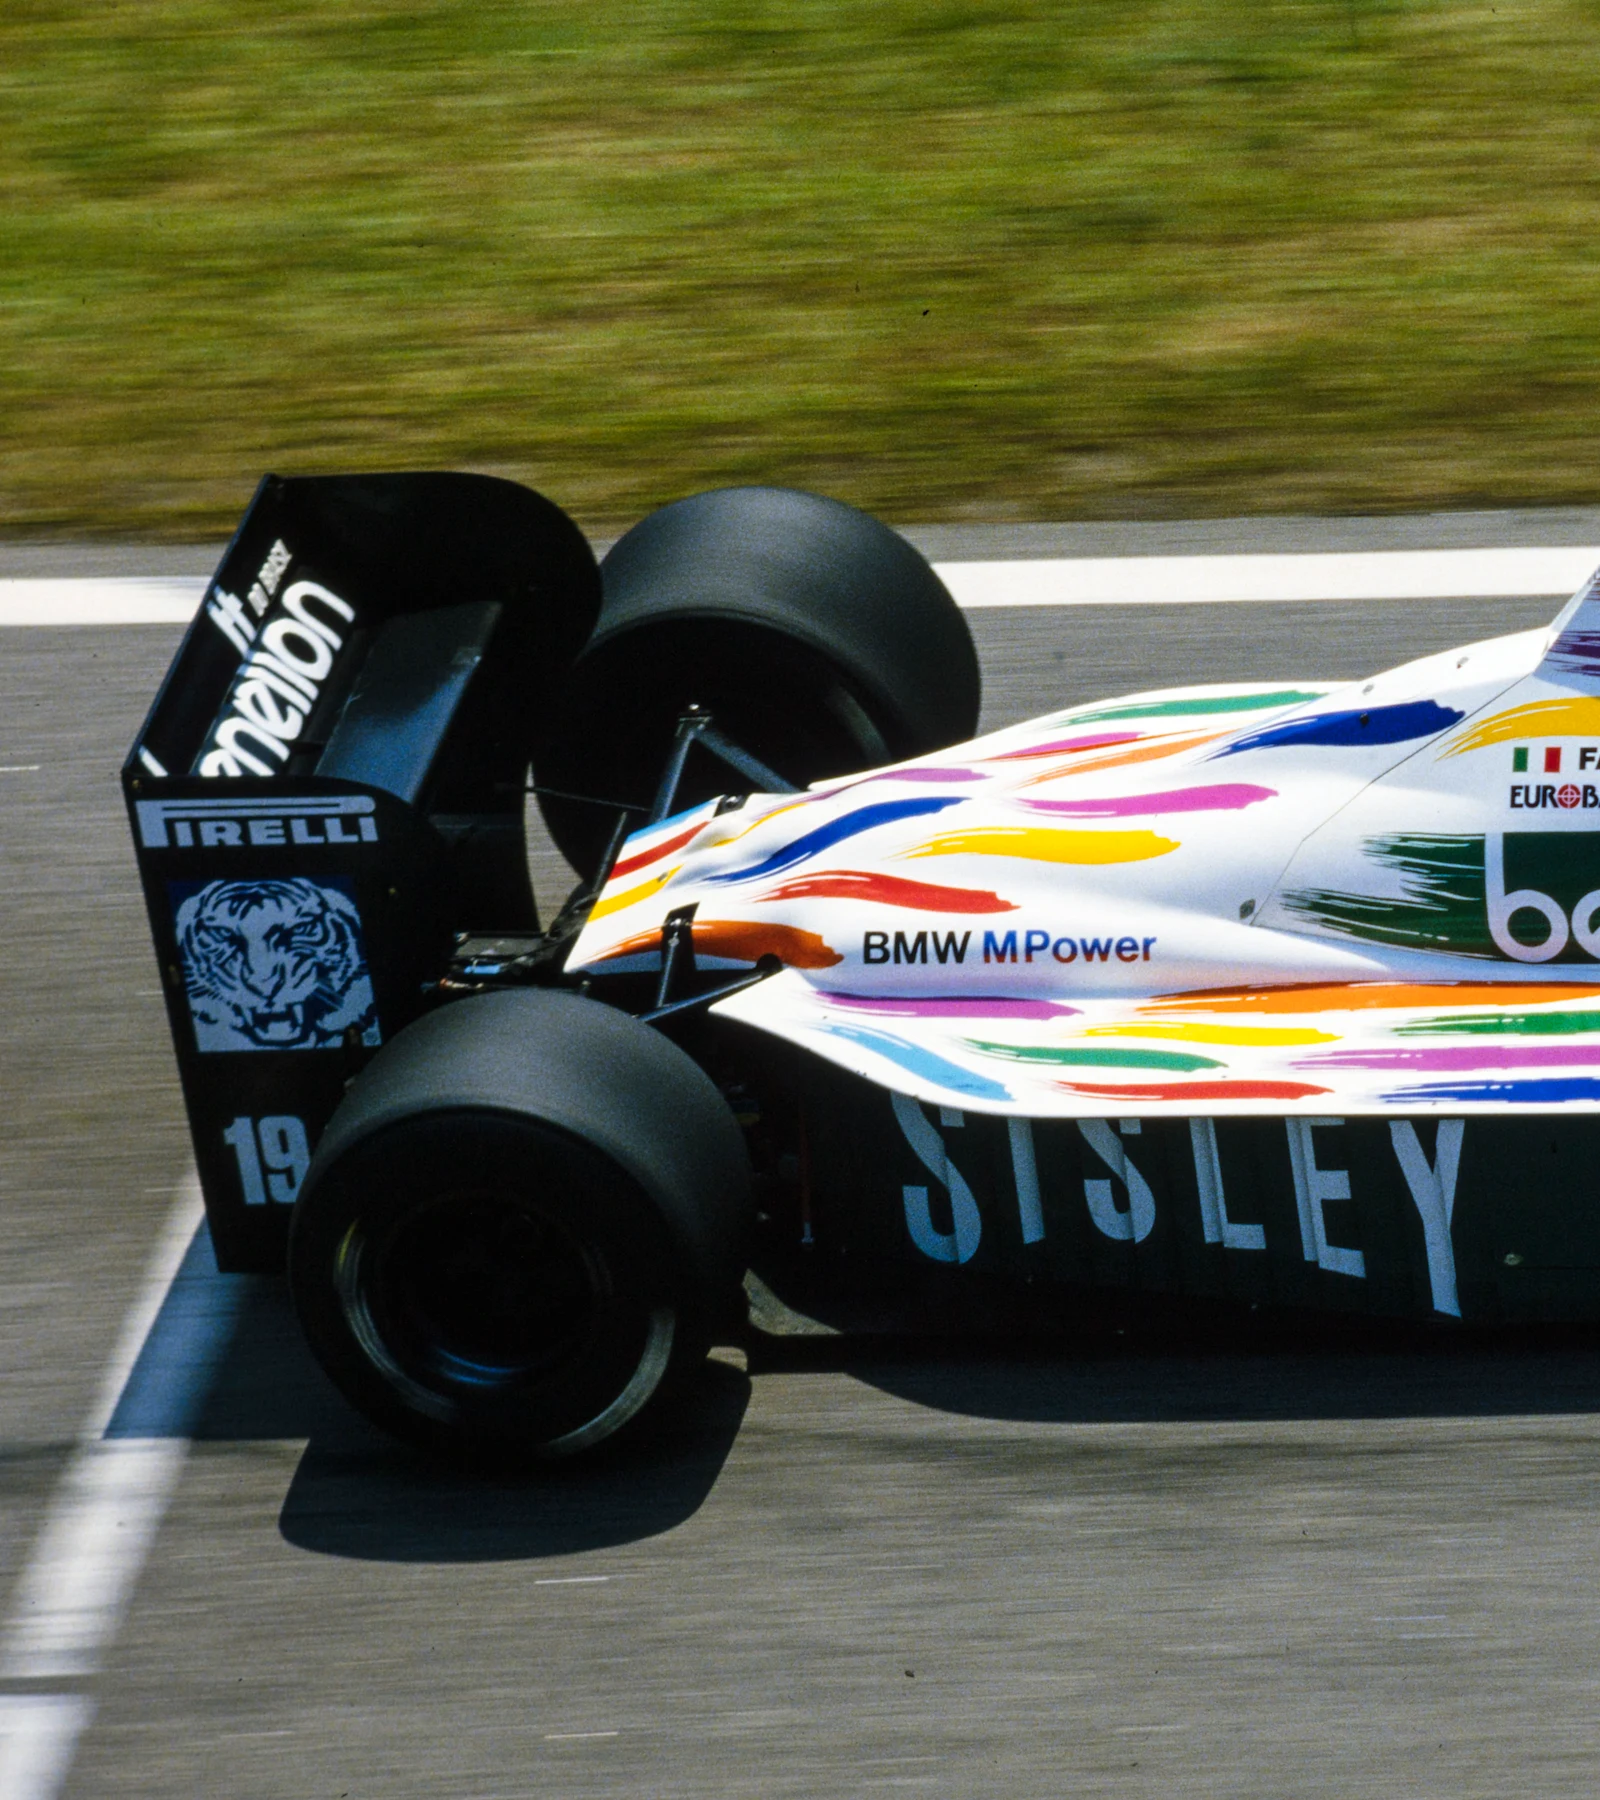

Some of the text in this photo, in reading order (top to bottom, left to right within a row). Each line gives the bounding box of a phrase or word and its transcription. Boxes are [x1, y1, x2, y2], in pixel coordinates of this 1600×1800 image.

[135, 796, 379, 848] PIRELLI
[862, 930, 972, 964] BMW
[224, 1115, 311, 1205] 19
[891, 1095, 1462, 1318] SISLEY
